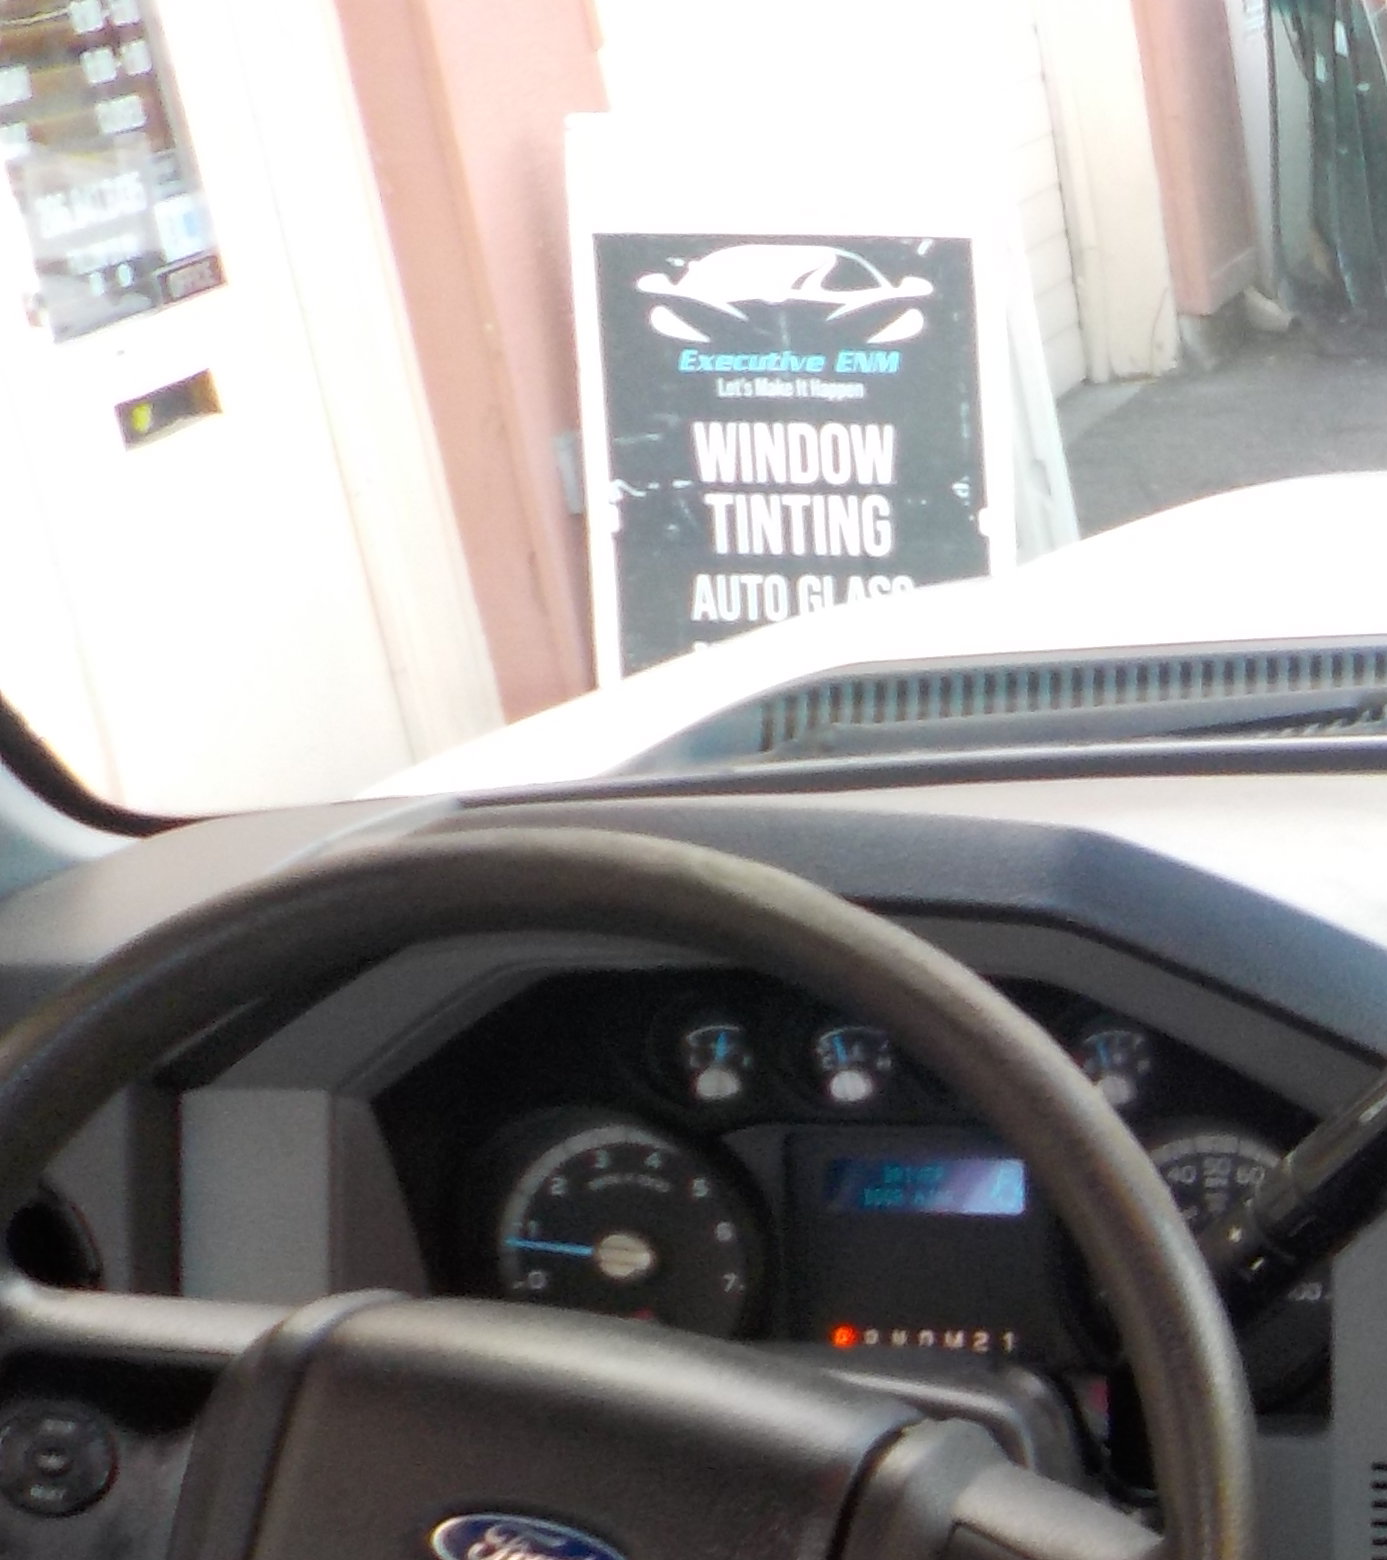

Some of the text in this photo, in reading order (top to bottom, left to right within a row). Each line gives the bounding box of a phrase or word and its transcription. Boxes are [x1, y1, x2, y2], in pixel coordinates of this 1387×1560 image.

[679, 349, 901, 373] Executive ENM
[717, 377, 752, 397] Let's
[754, 378, 793, 398] Make
[693, 421, 896, 485] WINDOW
[703, 493, 893, 557] TINTING
[691, 573, 789, 622] AUTO
